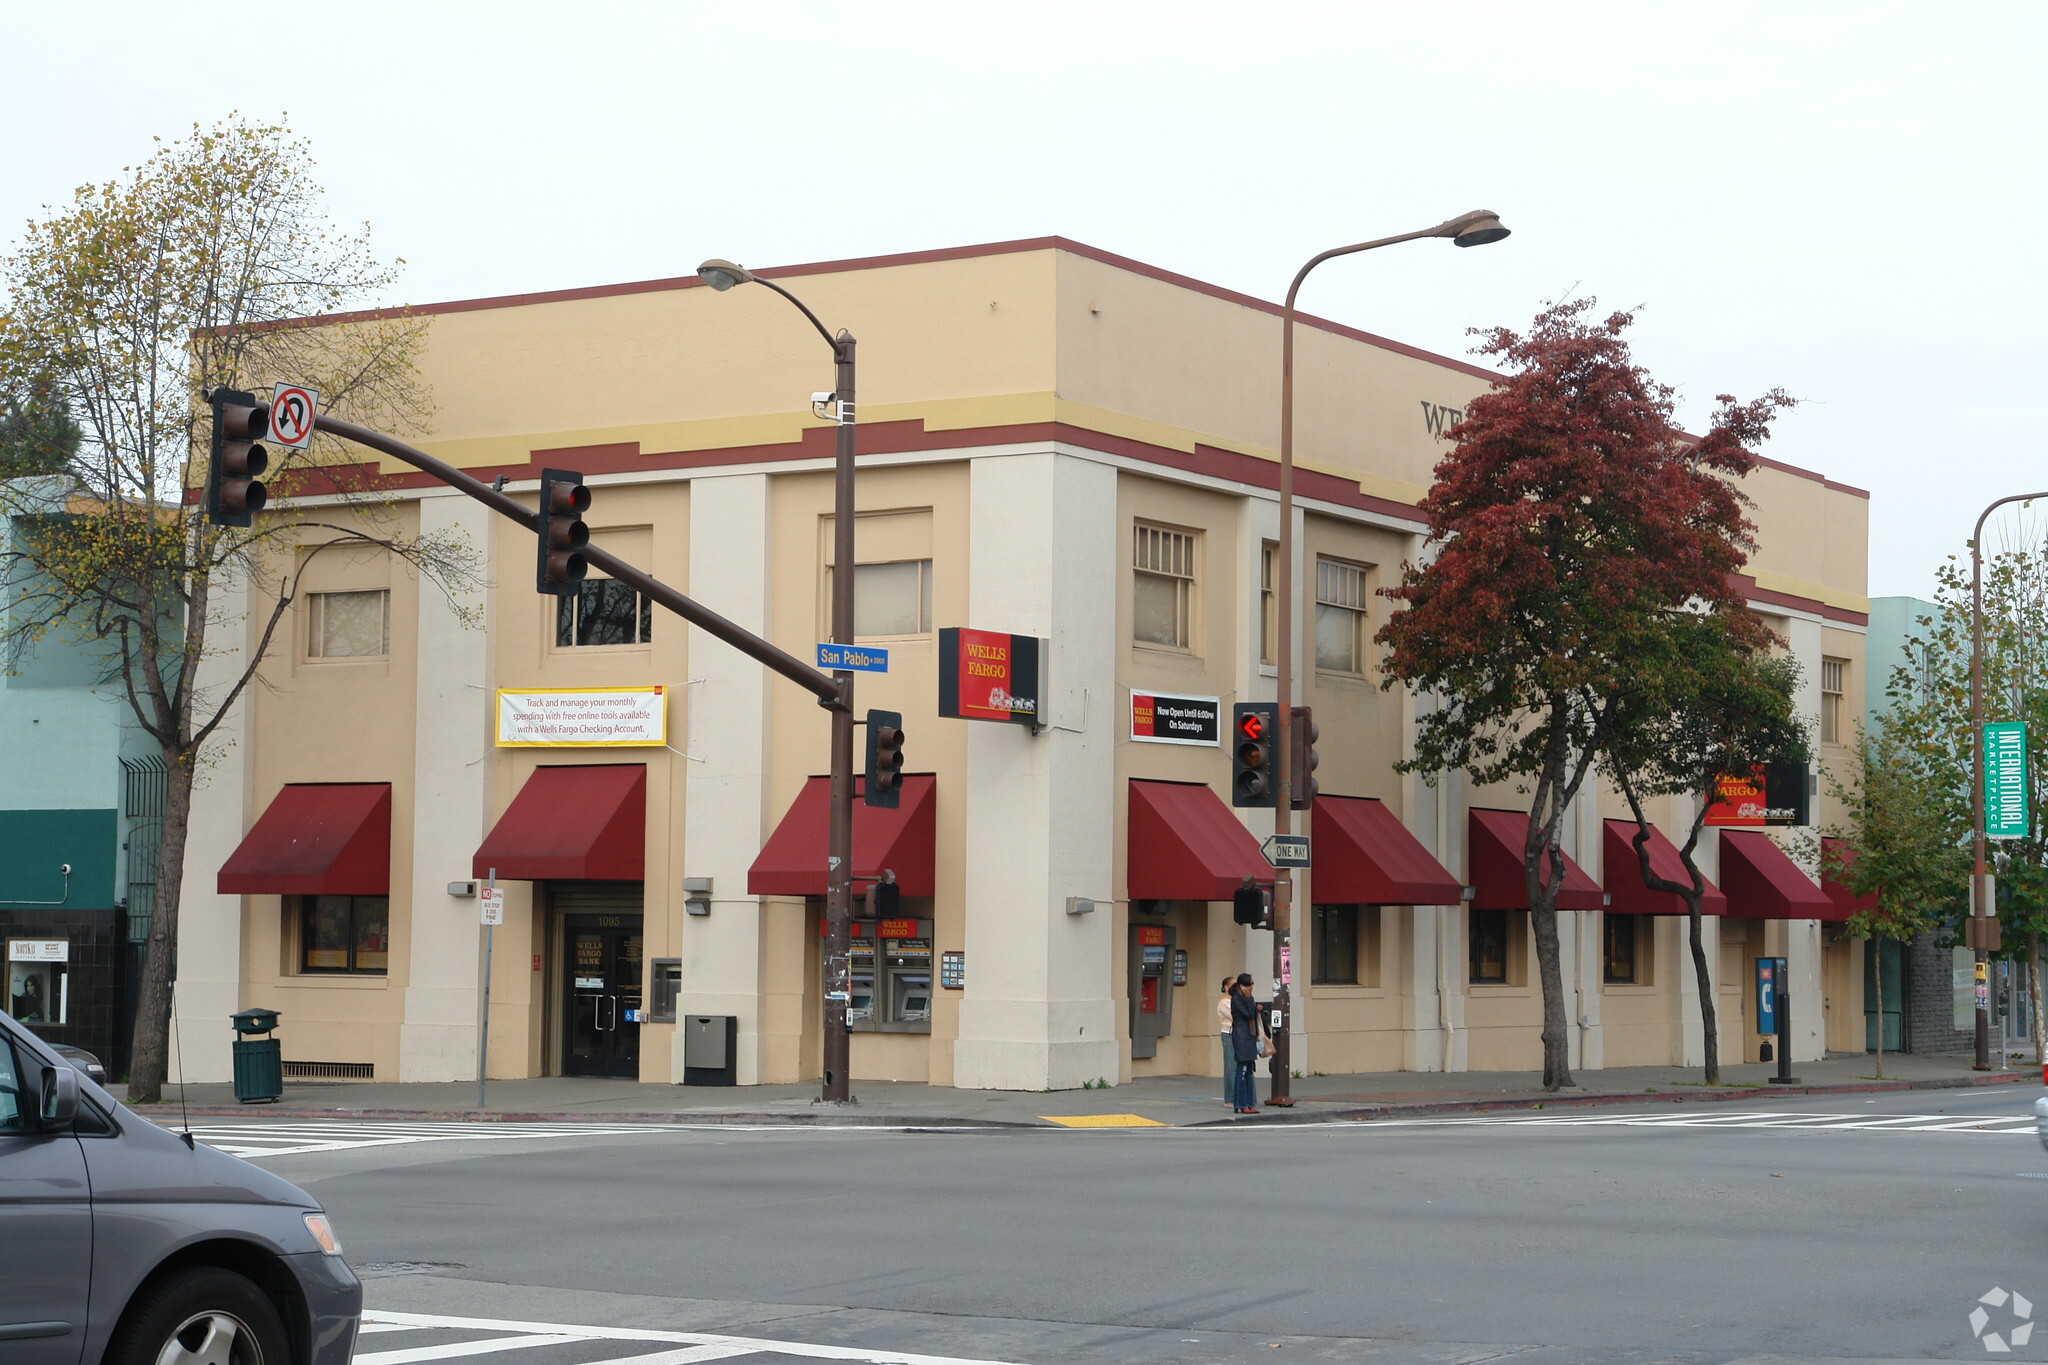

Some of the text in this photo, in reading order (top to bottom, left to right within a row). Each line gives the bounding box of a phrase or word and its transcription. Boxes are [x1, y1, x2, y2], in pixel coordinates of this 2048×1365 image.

[821, 648, 840, 664] San
[843, 650, 870, 667] Pablo
[967, 644, 1006, 660] WELLS
[967, 662, 1006, 678] FARGO
[526, 697, 637, 709] Track and manage your monthly
[512, 710, 650, 723] spending with free online tools available
[1134, 707, 1153, 716] WELLS
[1157, 706, 1169, 716] Now
[1169, 707, 1184, 719] Open
[1184, 708, 1197, 718] Until
[1134, 716, 1153, 725] FARGO
[1169, 720, 1203, 733] On Saturdays
[517, 724, 645, 736] with a Wells Fargo Checking Account.
[1988, 731, 1998, 830] MARKETPLACE
[1998, 730, 2023, 829] INTERNATIONAL
[1276, 845, 1306, 857] ONE WAY
[483, 890, 491, 898] NO
[599, 916, 620, 927] 1095
[882, 920, 908, 928] WELLS
[883, 928, 908, 936] FARGO
